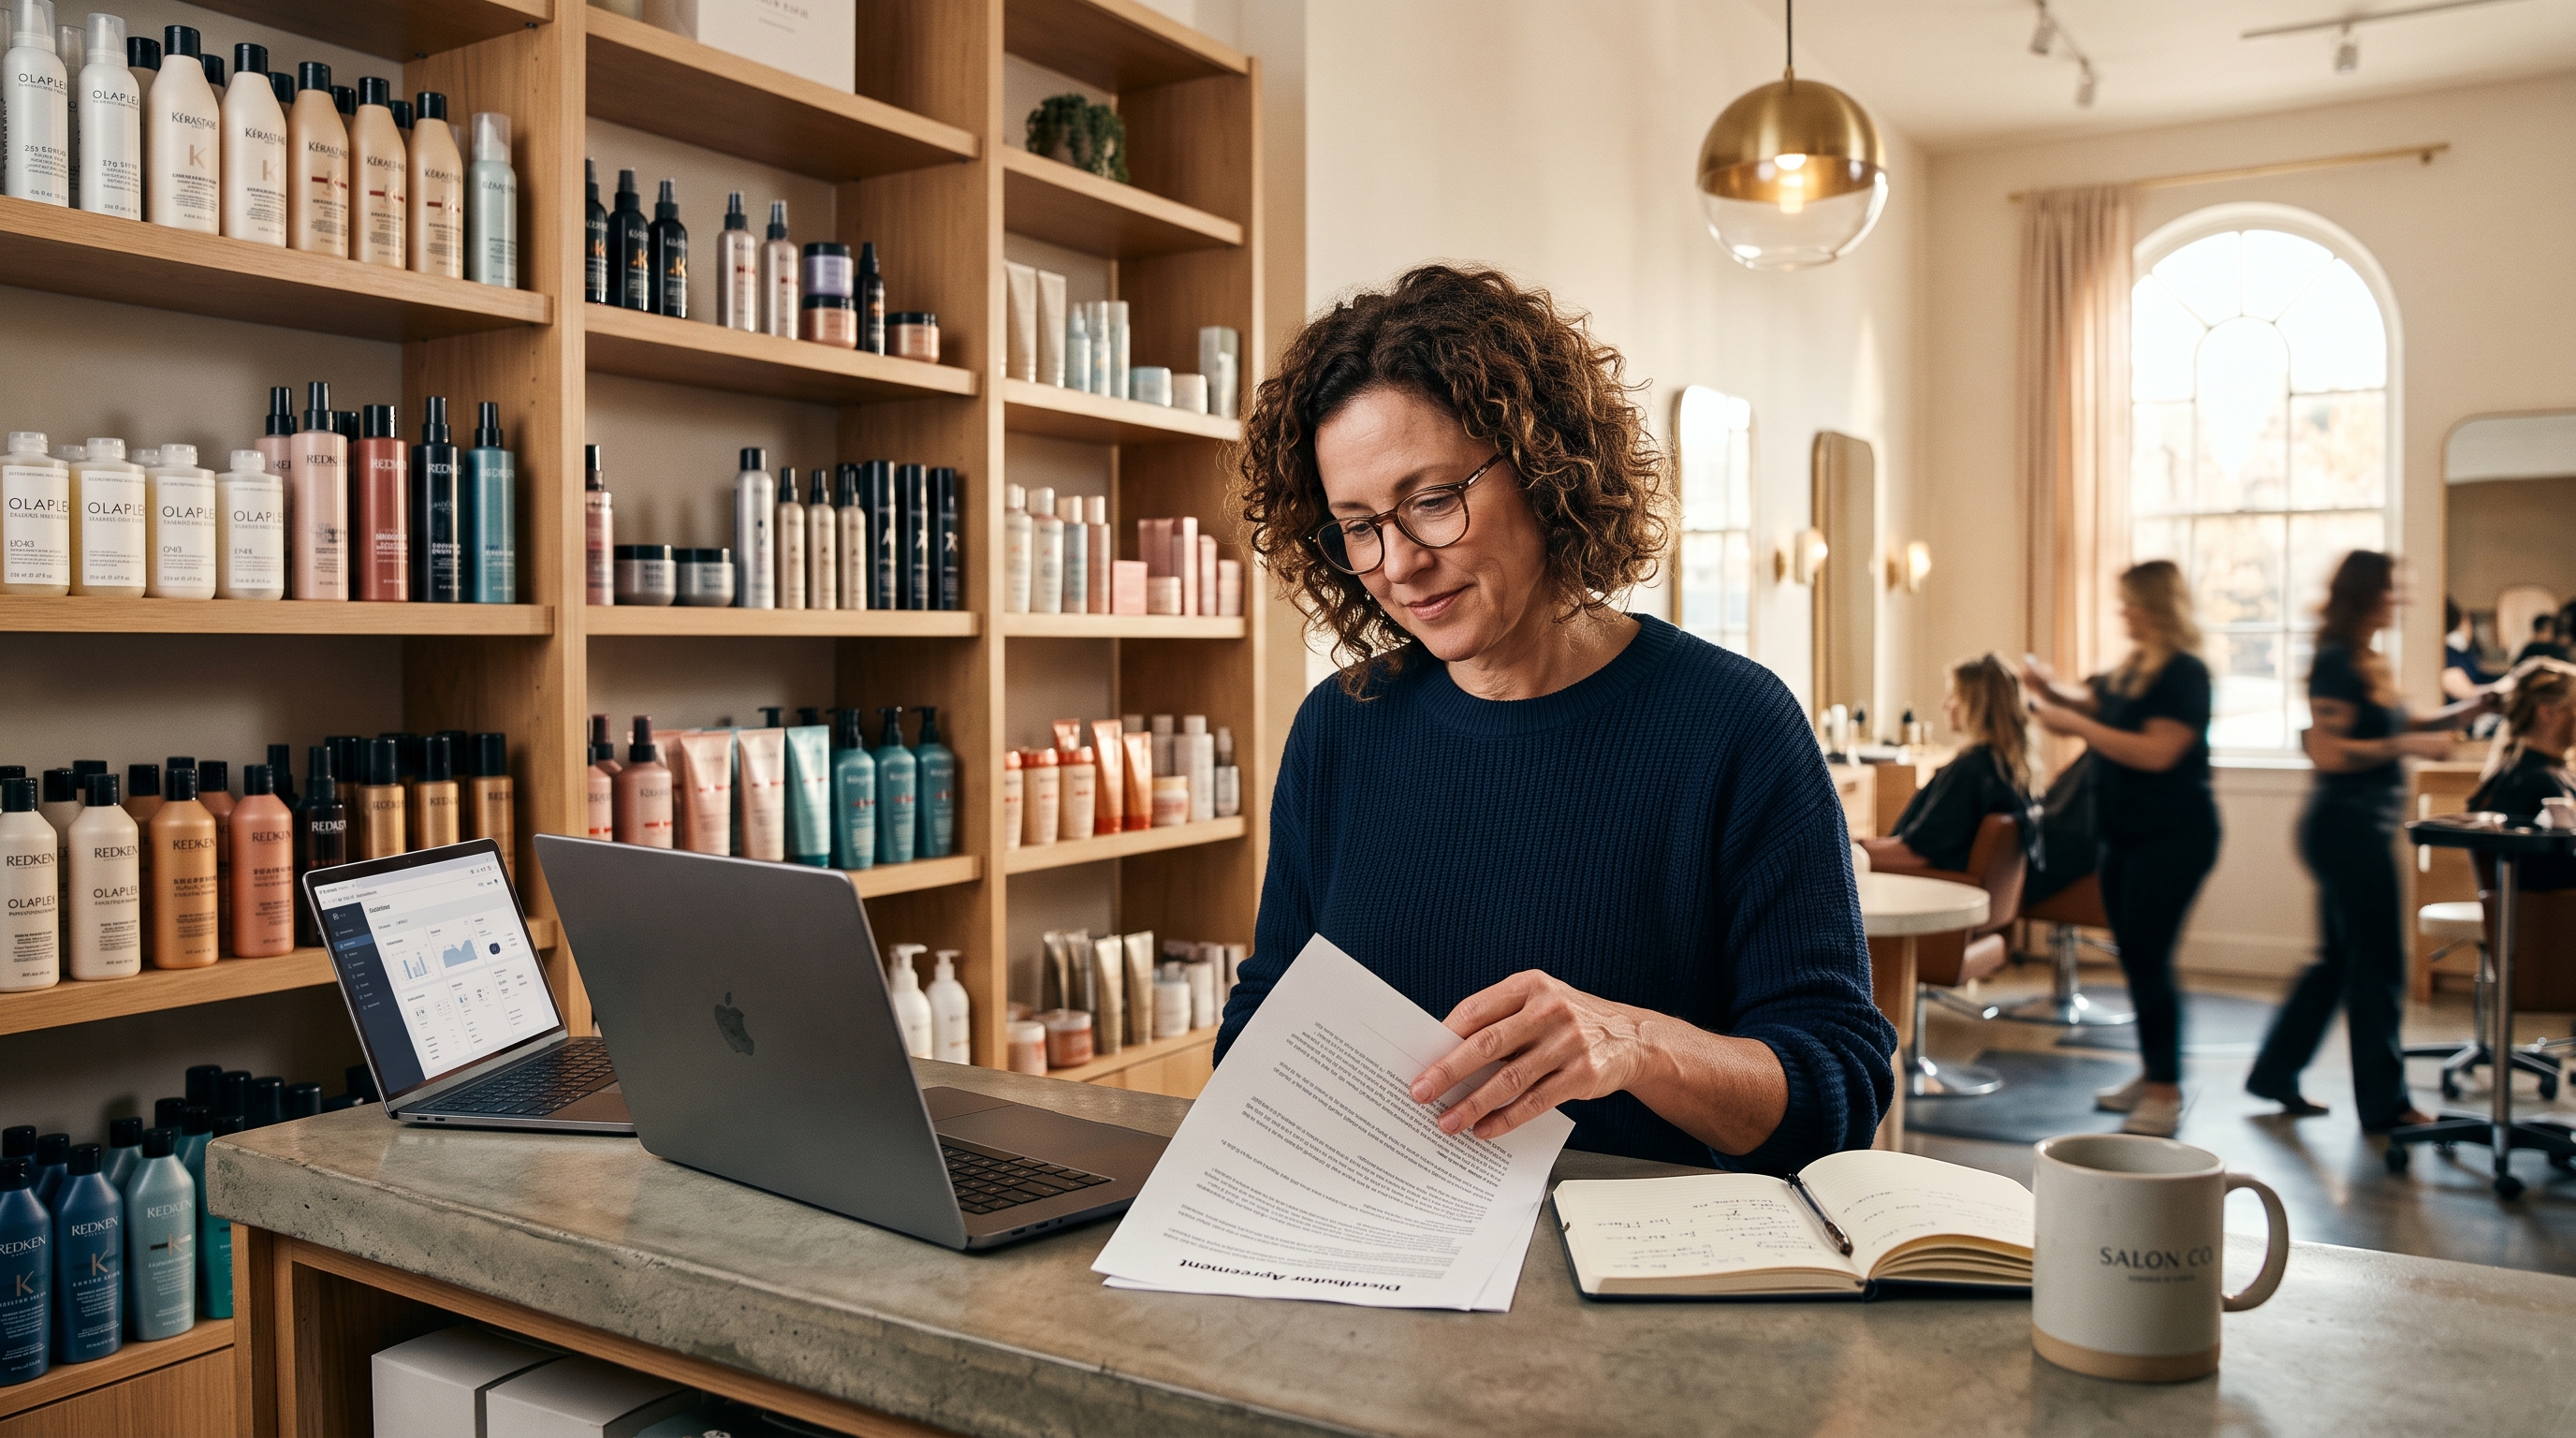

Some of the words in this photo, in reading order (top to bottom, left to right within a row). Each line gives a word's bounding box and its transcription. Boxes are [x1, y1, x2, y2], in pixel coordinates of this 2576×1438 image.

[88, 502, 145, 517] OLAPLE
[163, 506, 214, 520] OLAPLE
[234, 510, 283, 523] OLAPLE
[7, 853, 55, 867] REDKEN
[91, 1249, 110, 1276] K
[2100, 1246, 2181, 1269] SALON
[16, 1270, 35, 1297] K
